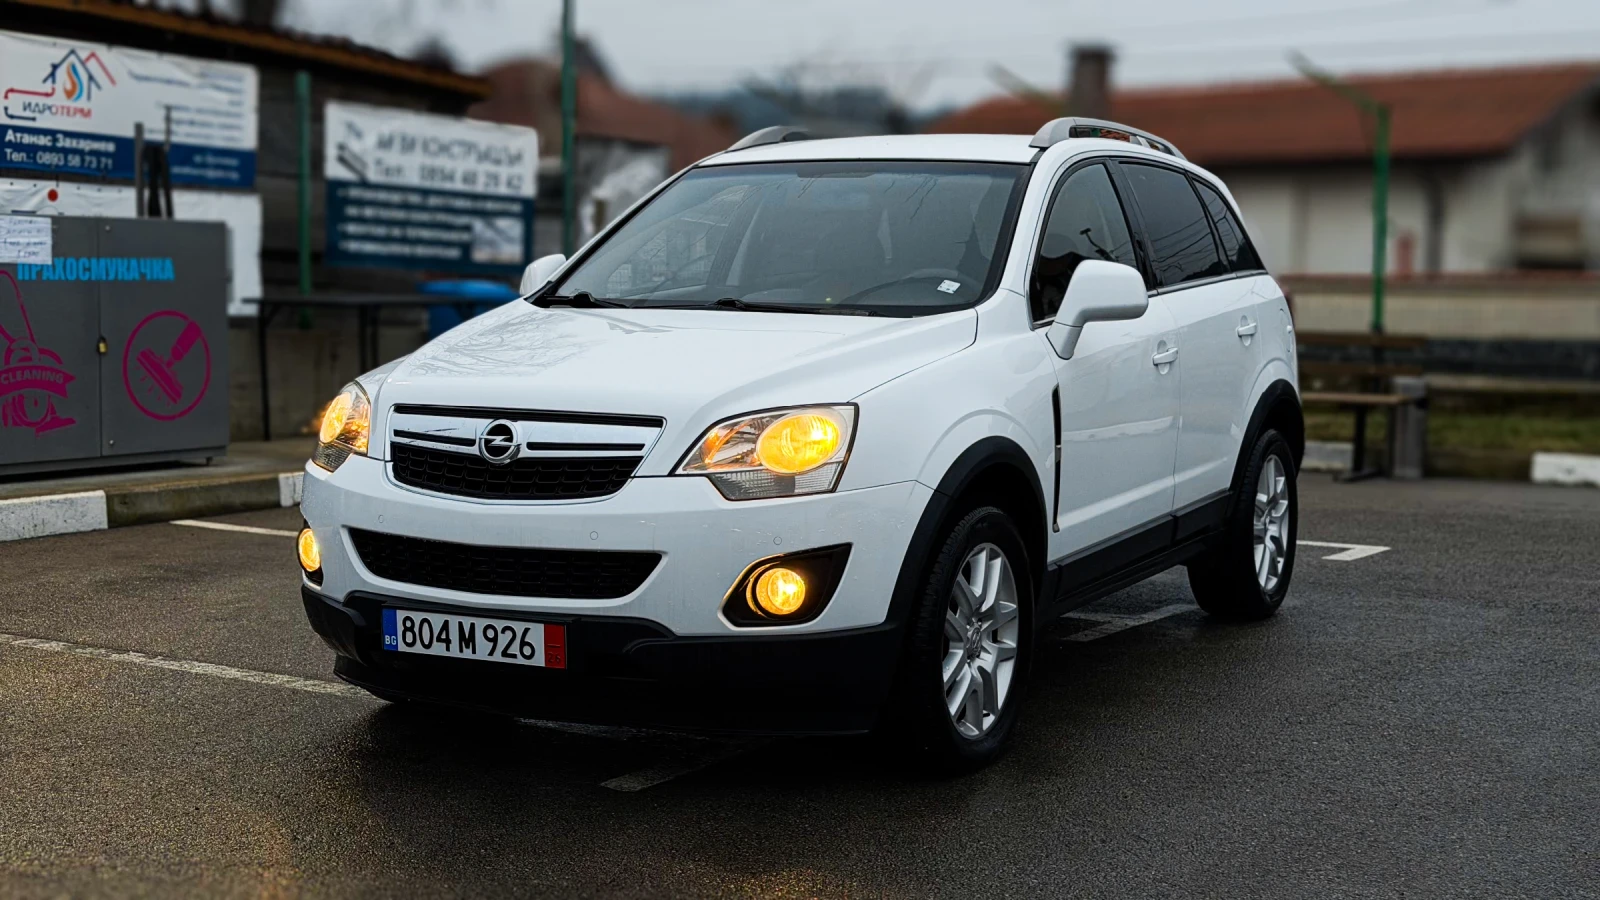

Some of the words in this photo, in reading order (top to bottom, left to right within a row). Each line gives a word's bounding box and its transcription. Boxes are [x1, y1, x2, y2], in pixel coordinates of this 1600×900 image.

[4, 129, 53, 147] Атанас
[55, 133, 116, 153] Захариев
[36, 151, 65, 166] 0893
[84, 155, 97, 169] 73
[100, 156, 113, 170] 71
[17, 257, 175, 281] ПРАХОСМУКАЧКА
[1, 369, 64, 384] CLEANING
[385, 635, 397, 646] BG
